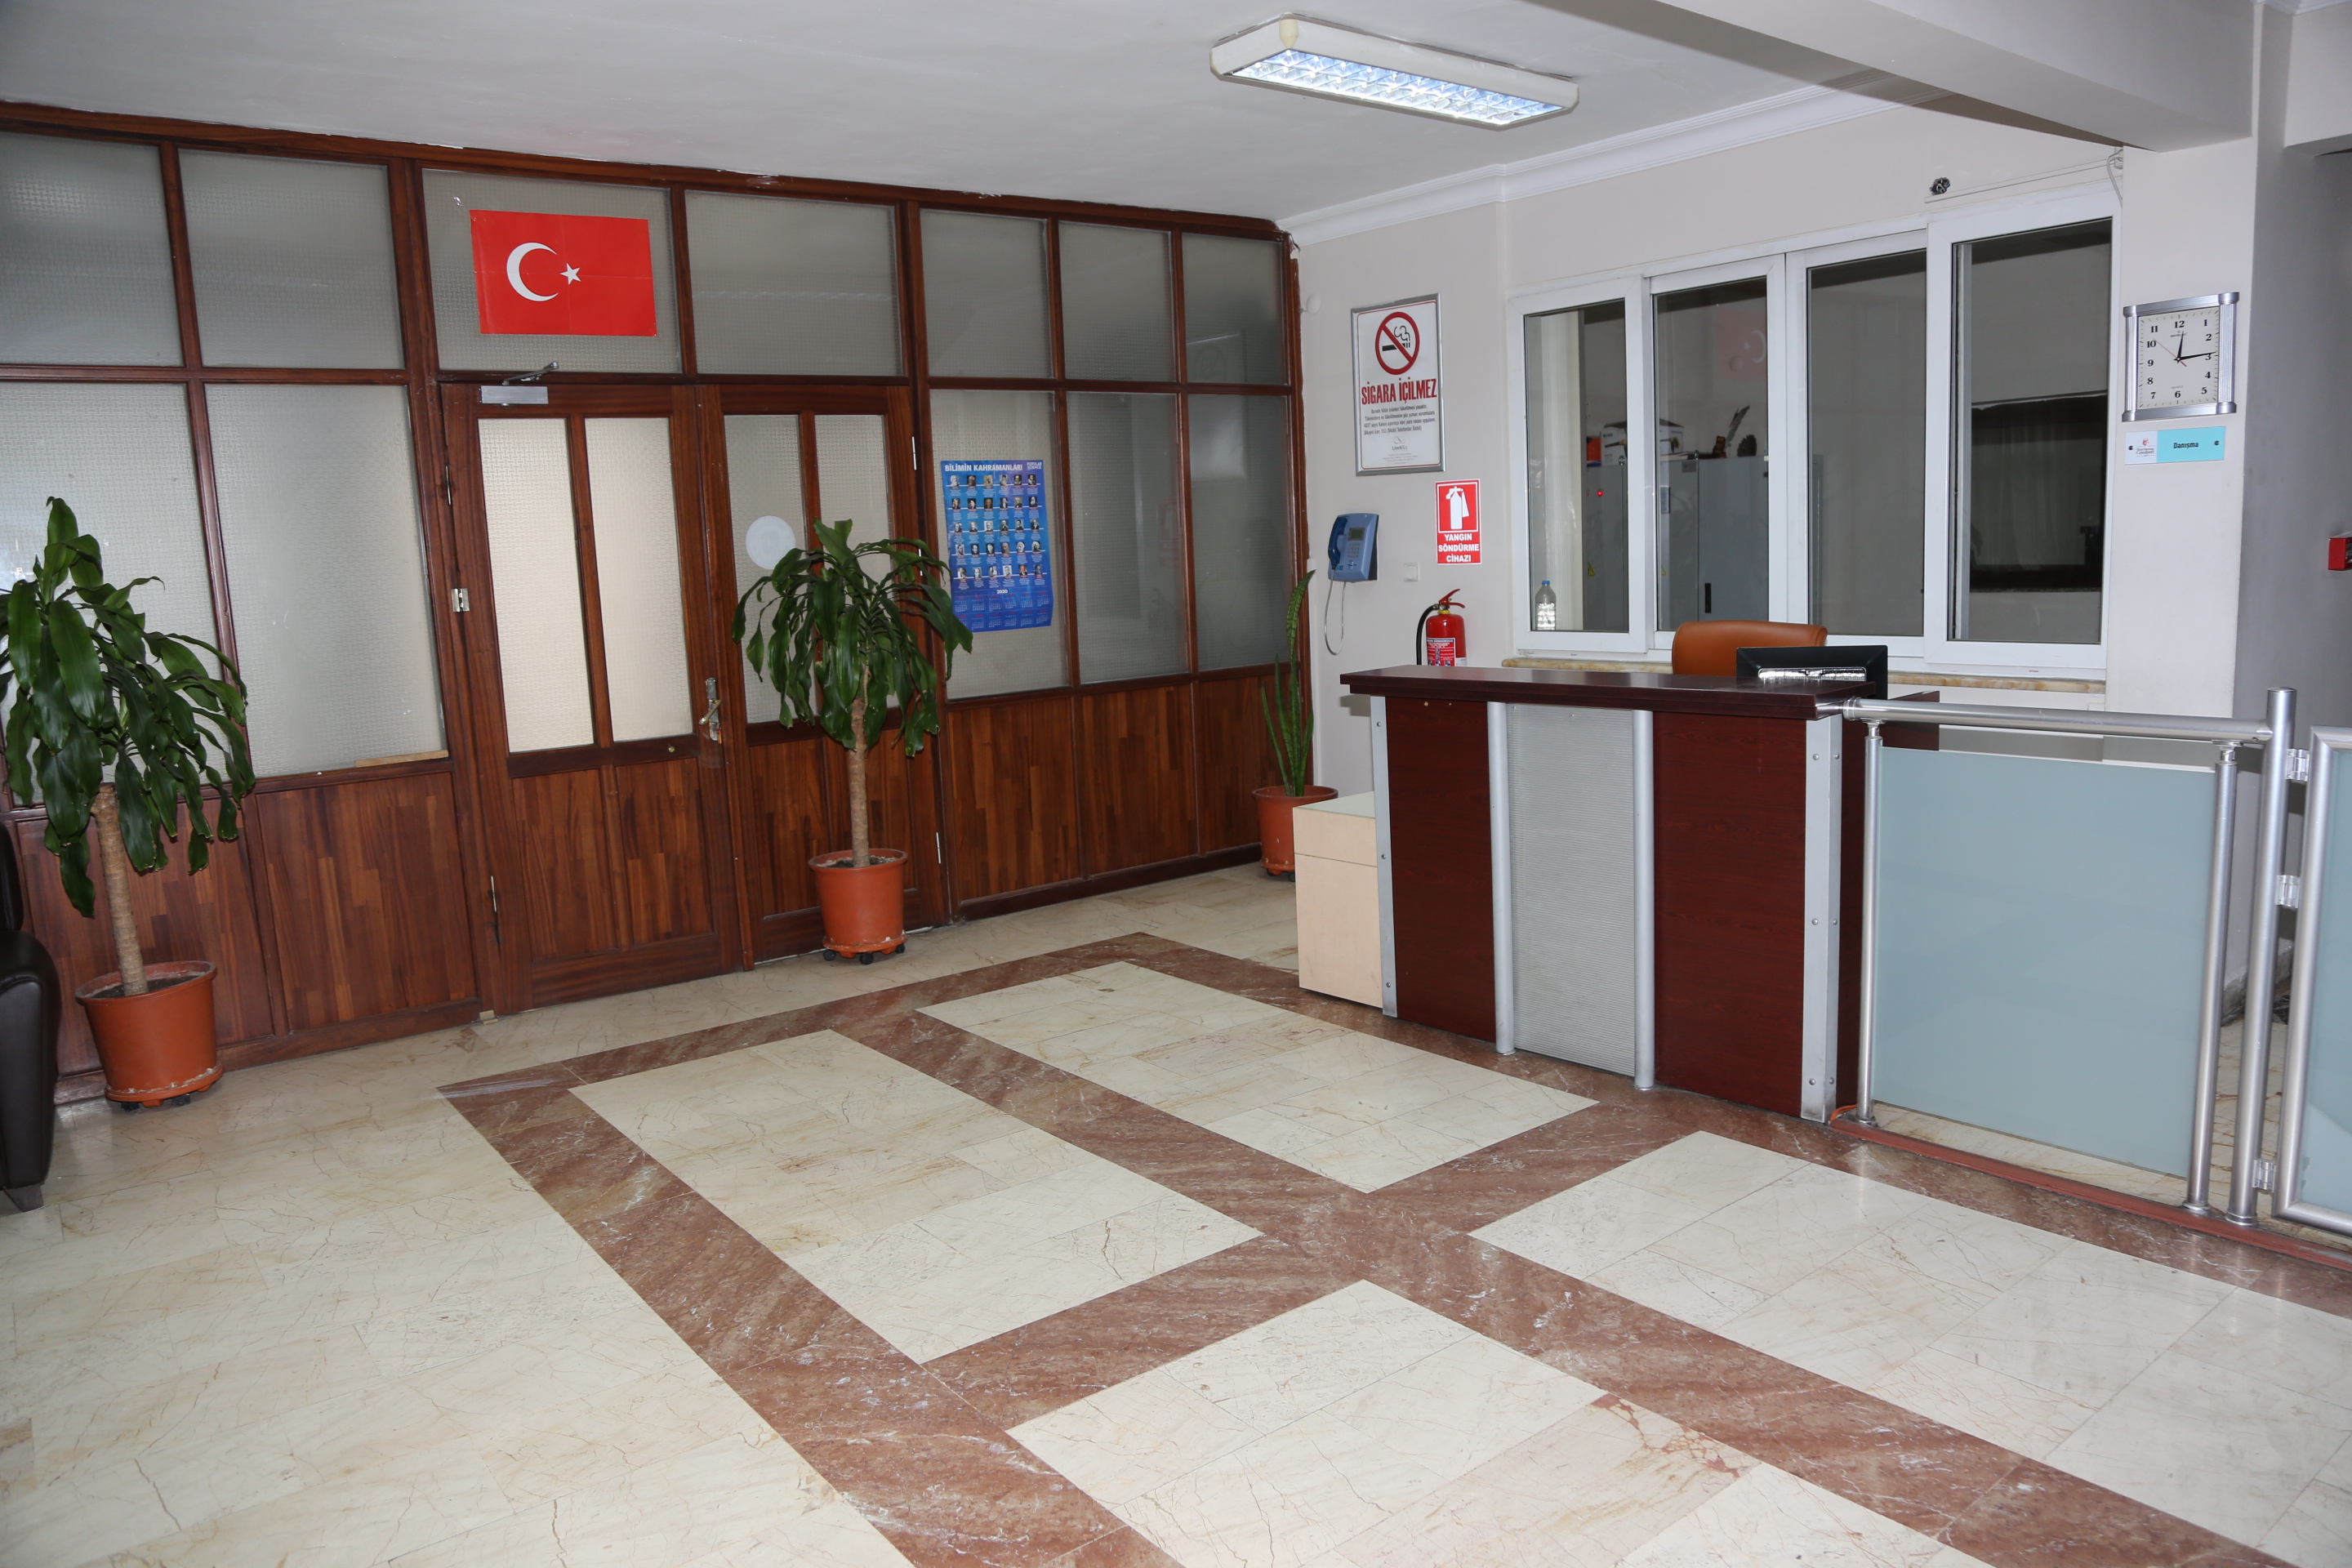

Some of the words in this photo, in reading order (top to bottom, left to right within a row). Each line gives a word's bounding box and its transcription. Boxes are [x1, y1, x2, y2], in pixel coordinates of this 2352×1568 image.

[2175, 320, 2185, 328] 12
[2206, 333, 2212, 341] 2
[2205, 353, 2212, 361] 3
[1361, 381, 1396, 405] SİGARA
[1399, 376, 1437, 403] İÇİLMEZ
[945, 463, 972, 471] BİLİMİN
[1444, 533, 1472, 541] YANGIN
[1438, 543, 1479, 552] SÖNDÜRME
[1446, 554, 1472, 563] CİHAZI
